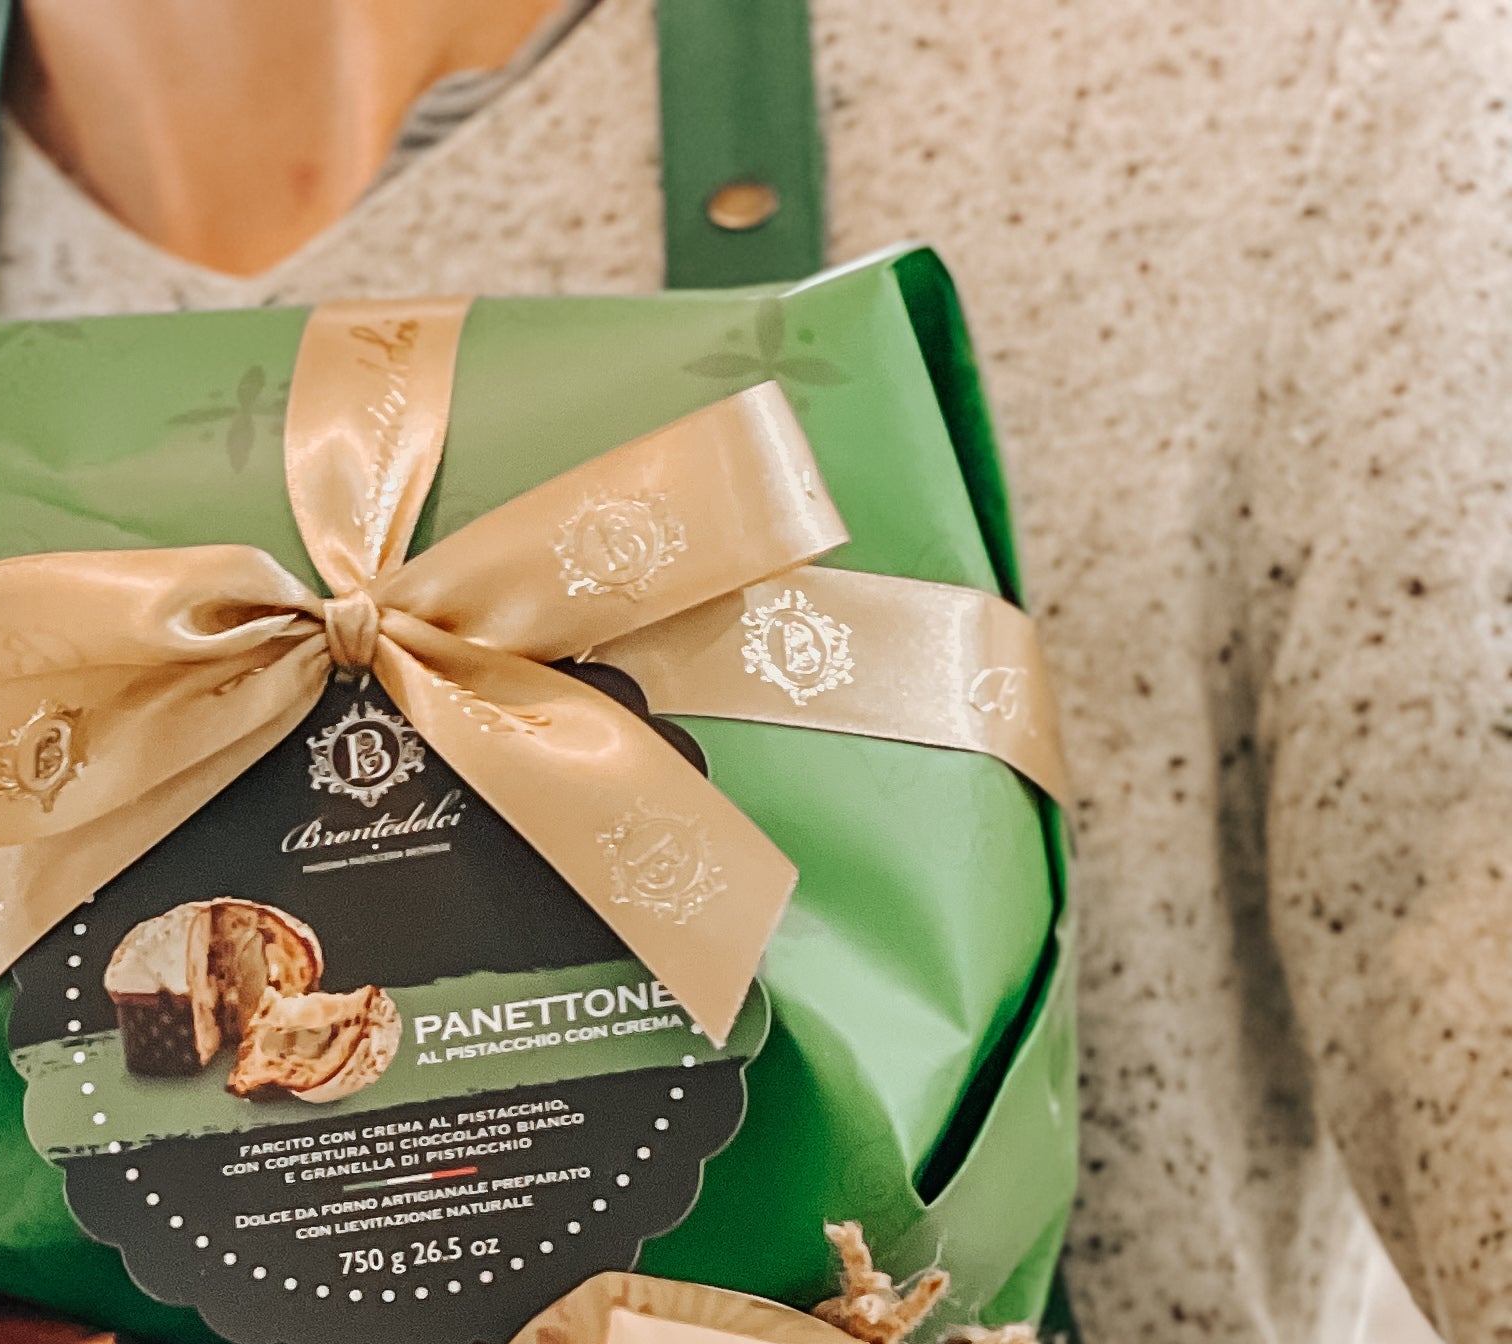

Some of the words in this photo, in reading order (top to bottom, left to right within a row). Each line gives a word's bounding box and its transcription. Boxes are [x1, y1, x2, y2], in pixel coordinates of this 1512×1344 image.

[281, 788, 467, 853] Brontedolci
[413, 980, 681, 1045] PANETTONE
[416, 1051, 443, 1067] AL
[445, 1031, 562, 1062] PISTACCHIO
[564, 1024, 609, 1043] CON
[612, 1013, 684, 1037] CREMA
[222, 1161, 260, 1177] CON
[264, 1144, 371, 1171] COPERTURA
[375, 1140, 395, 1154] DI
[399, 1123, 511, 1150] CIOCCOLATO
[516, 1112, 585, 1134] BIANCO
[240, 1136, 315, 1158] FARCITO
[319, 1129, 357, 1146] CON
[362, 1120, 424, 1140] CREMA
[429, 1116, 452, 1130] AL
[284, 1171, 297, 1184] E
[301, 1157, 396, 1182] GRANELLA
[400, 1154, 420, 1167] DI
[425, 1137, 533, 1163] PISTACCHIO
[234, 1209, 293, 1229] DOLCE
[294, 1207, 319, 1221] DA
[320, 1197, 379, 1216] FORNO
[381, 1181, 489, 1209] ARTIGIANALE
[491, 1166, 591, 1192] PREPARATO
[295, 1224, 332, 1240] CON
[334, 1207, 445, 1234] LIEVITAZIONE
[446, 1194, 535, 1218] NATURALE
[338, 1247, 385, 1275] 750
[390, 1250, 408, 1275] g
[410, 1236, 463, 1266] 26.5
[470, 1237, 501, 1257] oz
